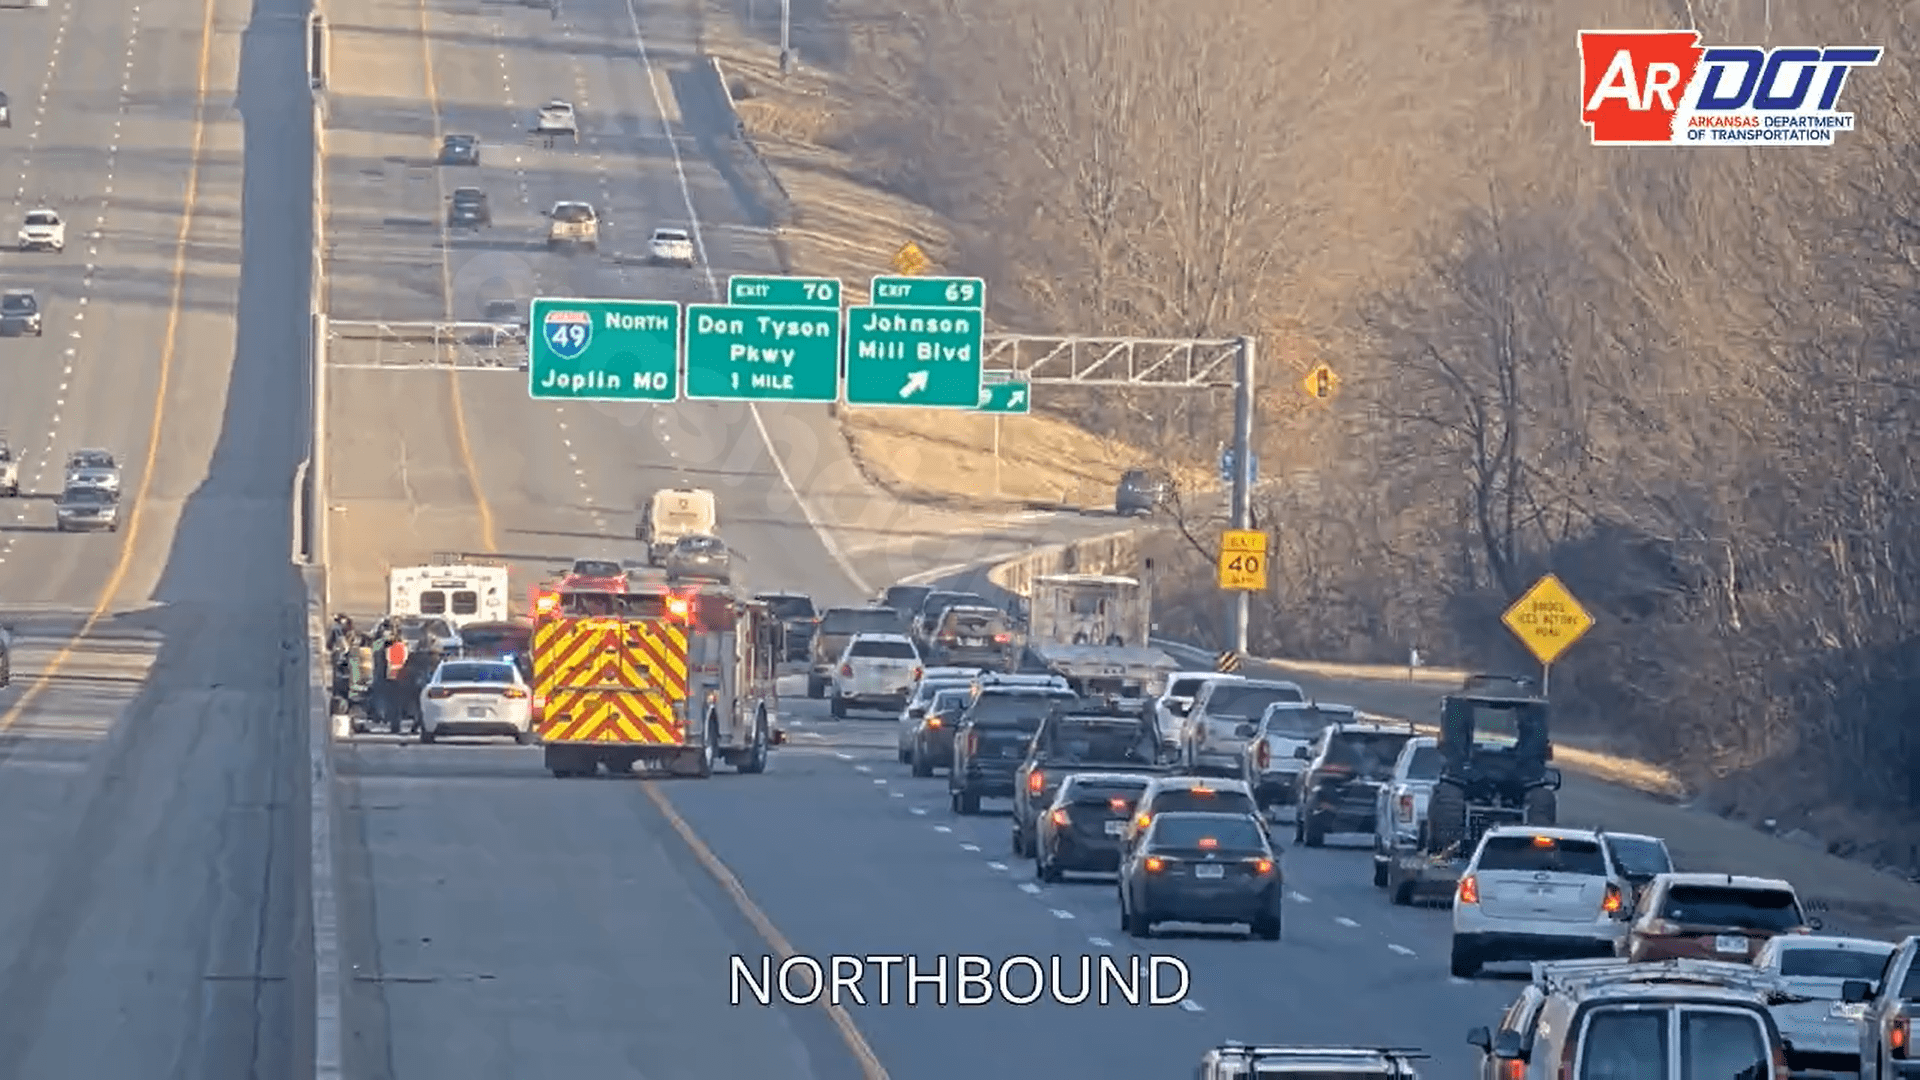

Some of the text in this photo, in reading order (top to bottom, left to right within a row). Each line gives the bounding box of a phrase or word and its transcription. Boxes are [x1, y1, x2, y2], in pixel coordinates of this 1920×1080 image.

[735, 283, 833, 300] EXIT 70
[878, 283, 974, 301] EXIT 69
[605, 312, 668, 330] NORTH
[698, 314, 830, 340] Don Tyson
[863, 312, 970, 333] Johnson
[552, 324, 586, 348] 49
[730, 343, 795, 367] Pkwy
[859, 340, 971, 361] Mill Blvd
[541, 369, 668, 392] Joplin MO
[731, 372, 794, 390] 1 MILE
[1228, 555, 1259, 574] 40
